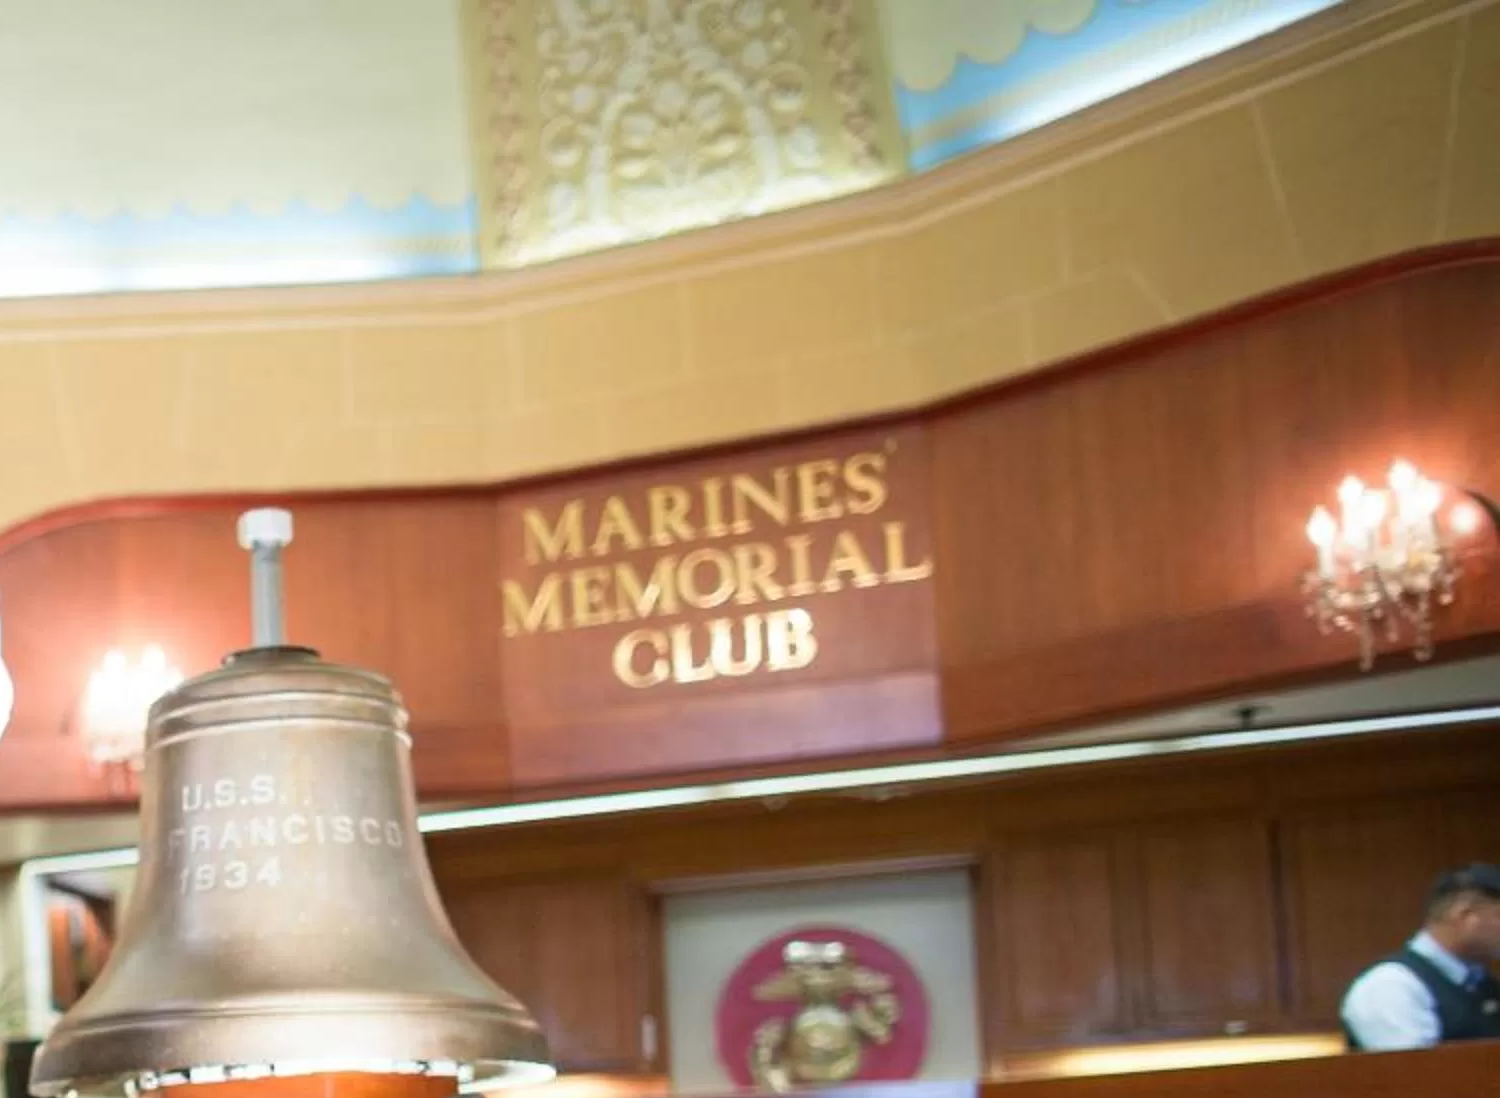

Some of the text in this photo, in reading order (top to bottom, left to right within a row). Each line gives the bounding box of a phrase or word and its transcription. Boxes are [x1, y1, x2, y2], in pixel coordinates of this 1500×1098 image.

[502, 521, 934, 637] MEMORIAL
[612, 607, 818, 689] CLUB
[168, 813, 404, 858] FRANCISCO
[180, 856, 283, 896] 1934
